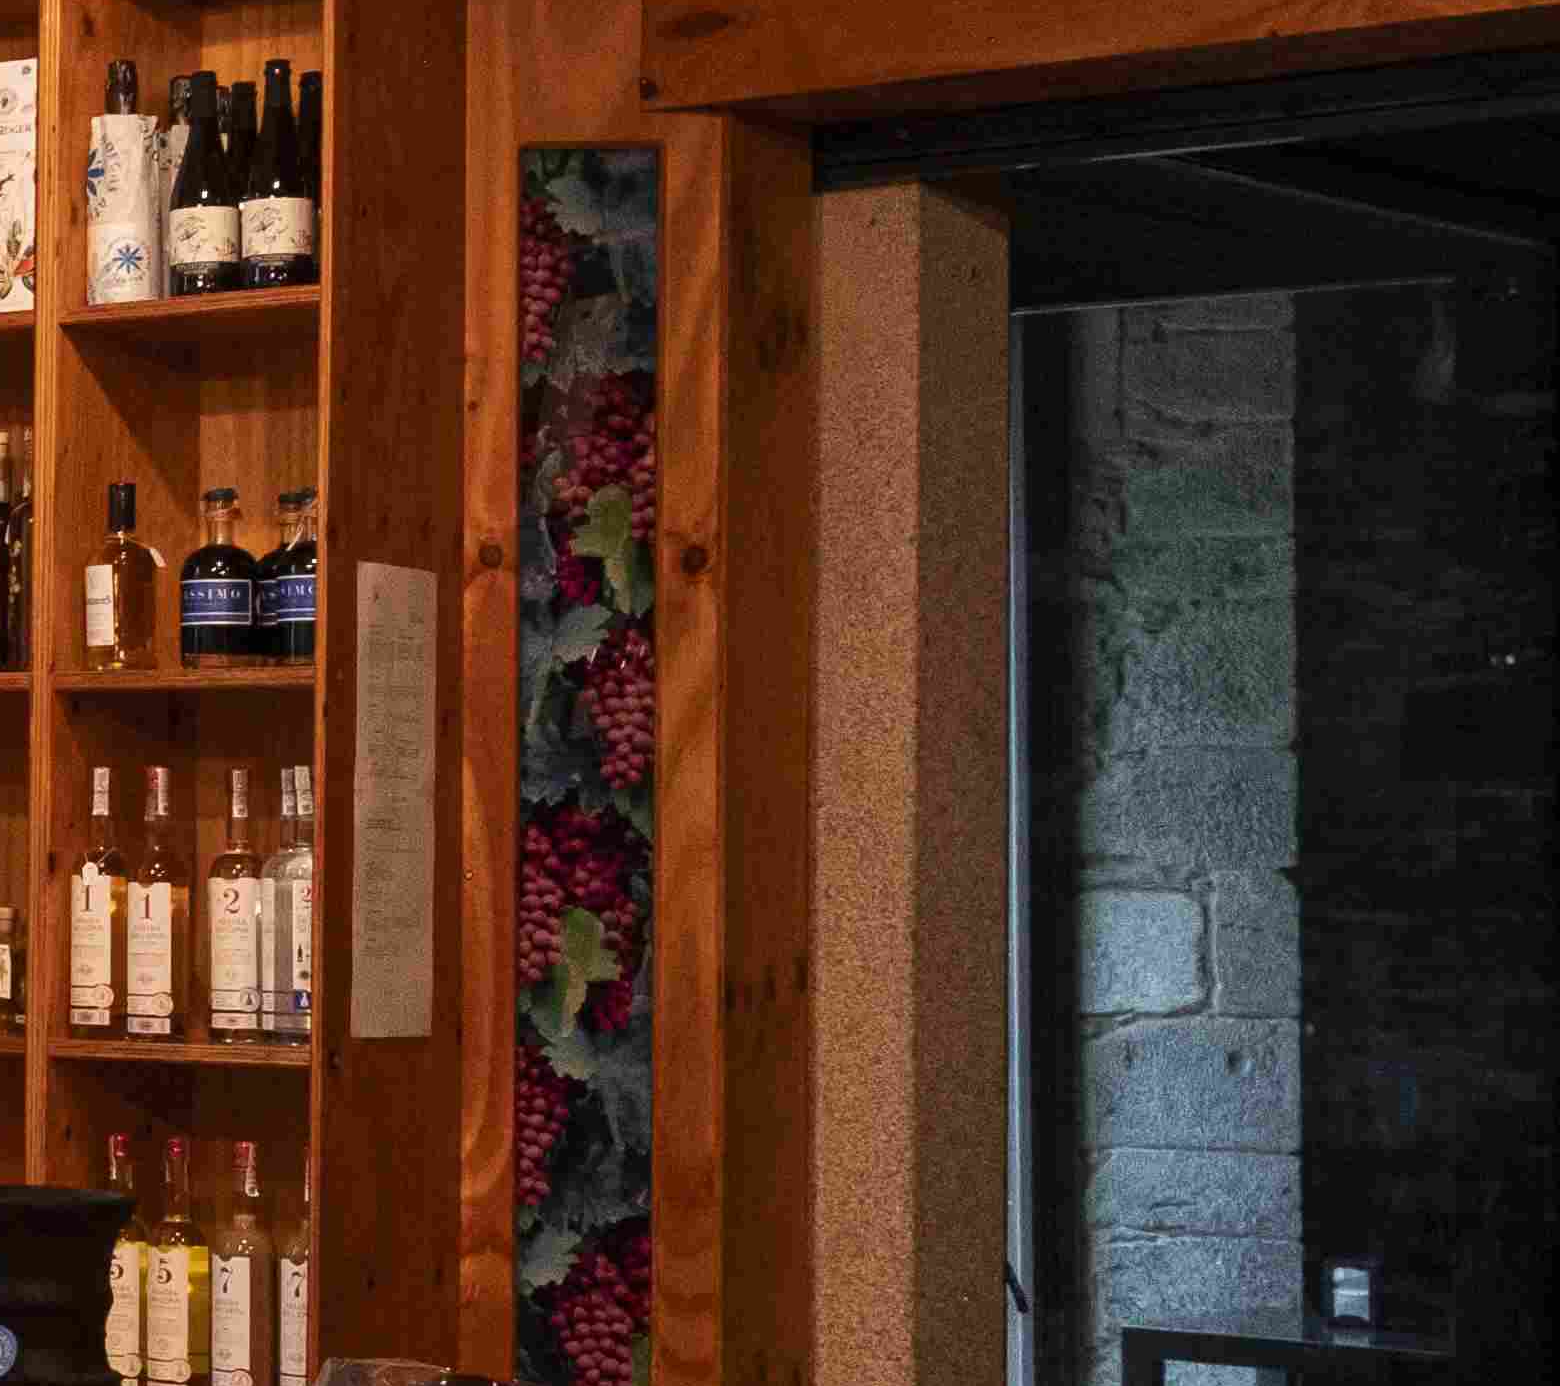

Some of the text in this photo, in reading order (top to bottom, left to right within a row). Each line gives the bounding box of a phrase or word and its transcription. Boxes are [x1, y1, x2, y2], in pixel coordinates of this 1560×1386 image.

[142, 893, 152, 919] 1
[223, 888, 240, 913] 2
[156, 1258, 172, 1284] 5
[219, 1266, 233, 1294] 7
[291, 1270, 305, 1298] 7
